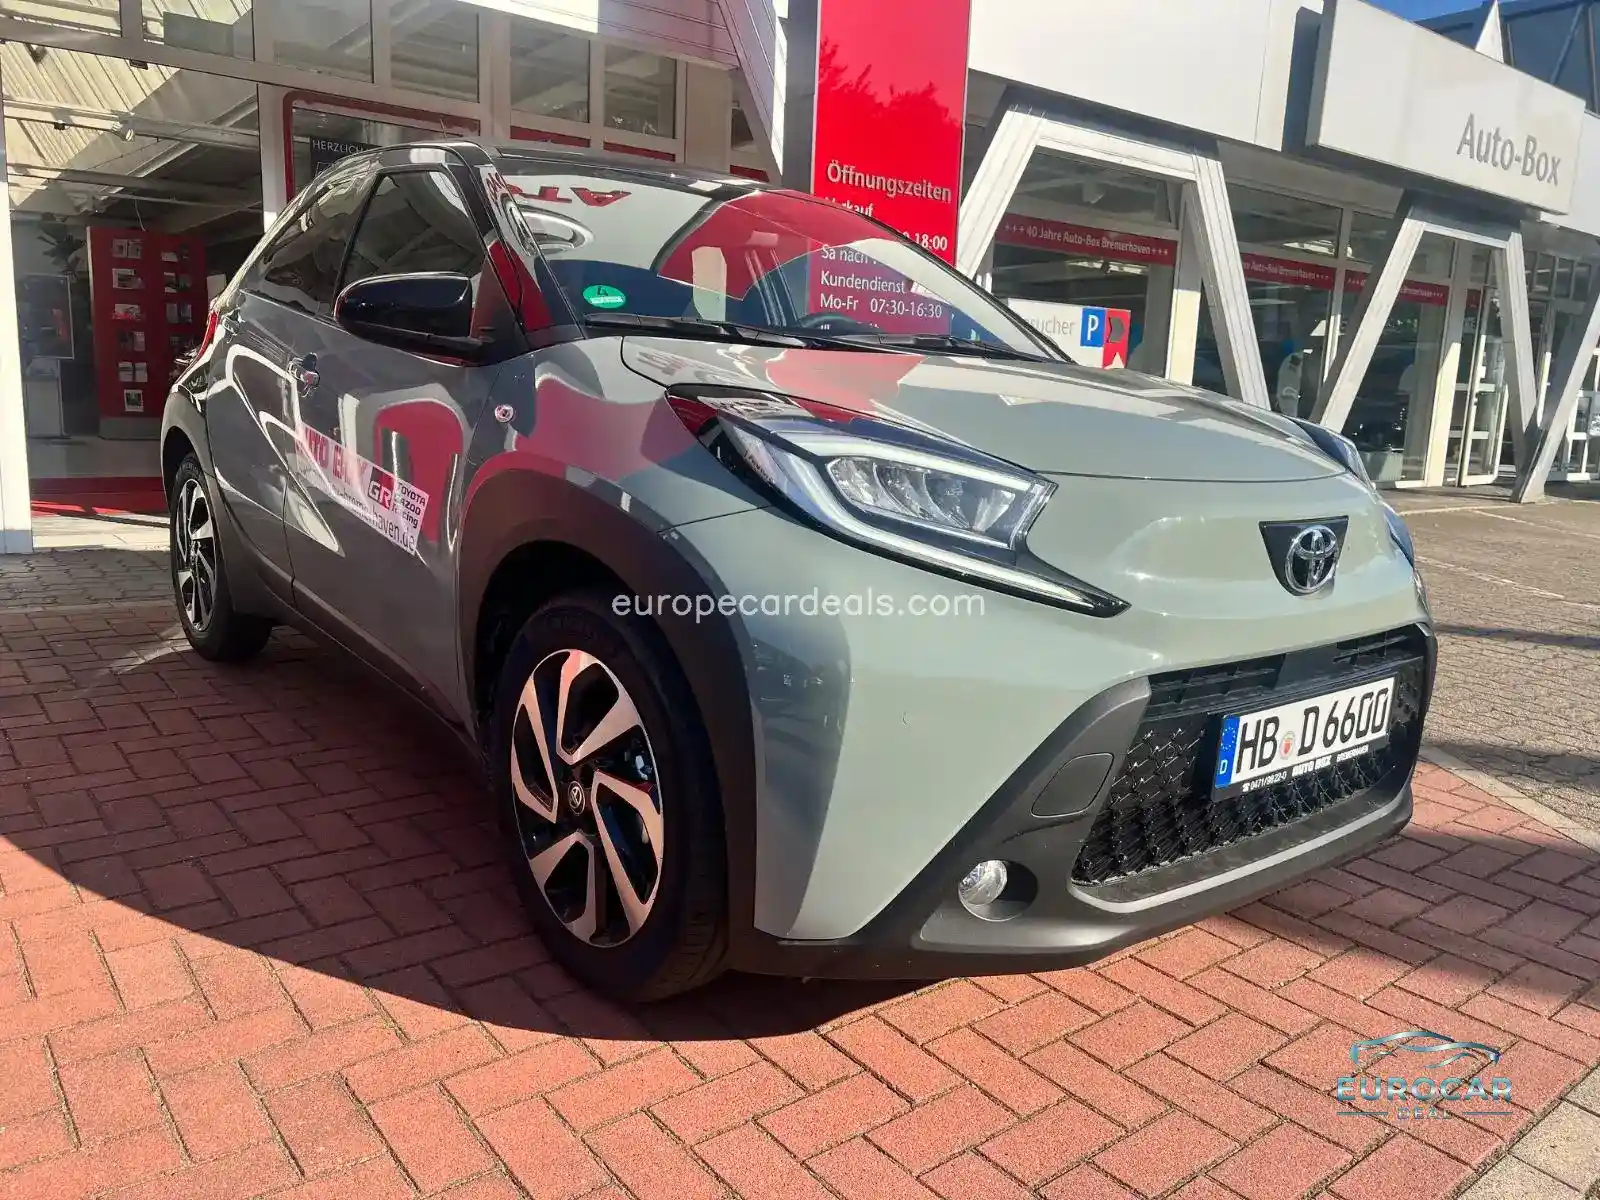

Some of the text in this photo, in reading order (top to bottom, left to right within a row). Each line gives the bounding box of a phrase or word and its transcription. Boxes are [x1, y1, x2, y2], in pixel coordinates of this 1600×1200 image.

[1456, 112, 1562, 187] Auto-Box
[827, 160, 952, 203] Öffnungszeiten
[821, 244, 836, 260] Sa
[1026, 225, 1038, 238] 40
[1038, 227, 1062, 242] Jahre
[1063, 230, 1101, 248] Auto-Box
[1101, 236, 1151, 254] Bremerhaven
[820, 270, 907, 294] Kundendienst
[820, 293, 943, 319] Mo-Fr 07:30-16:30
[1025, 314, 1099, 340] sucher P
[368, 480, 392, 510] GR
[1236, 687, 1389, 774] HB D 6600
